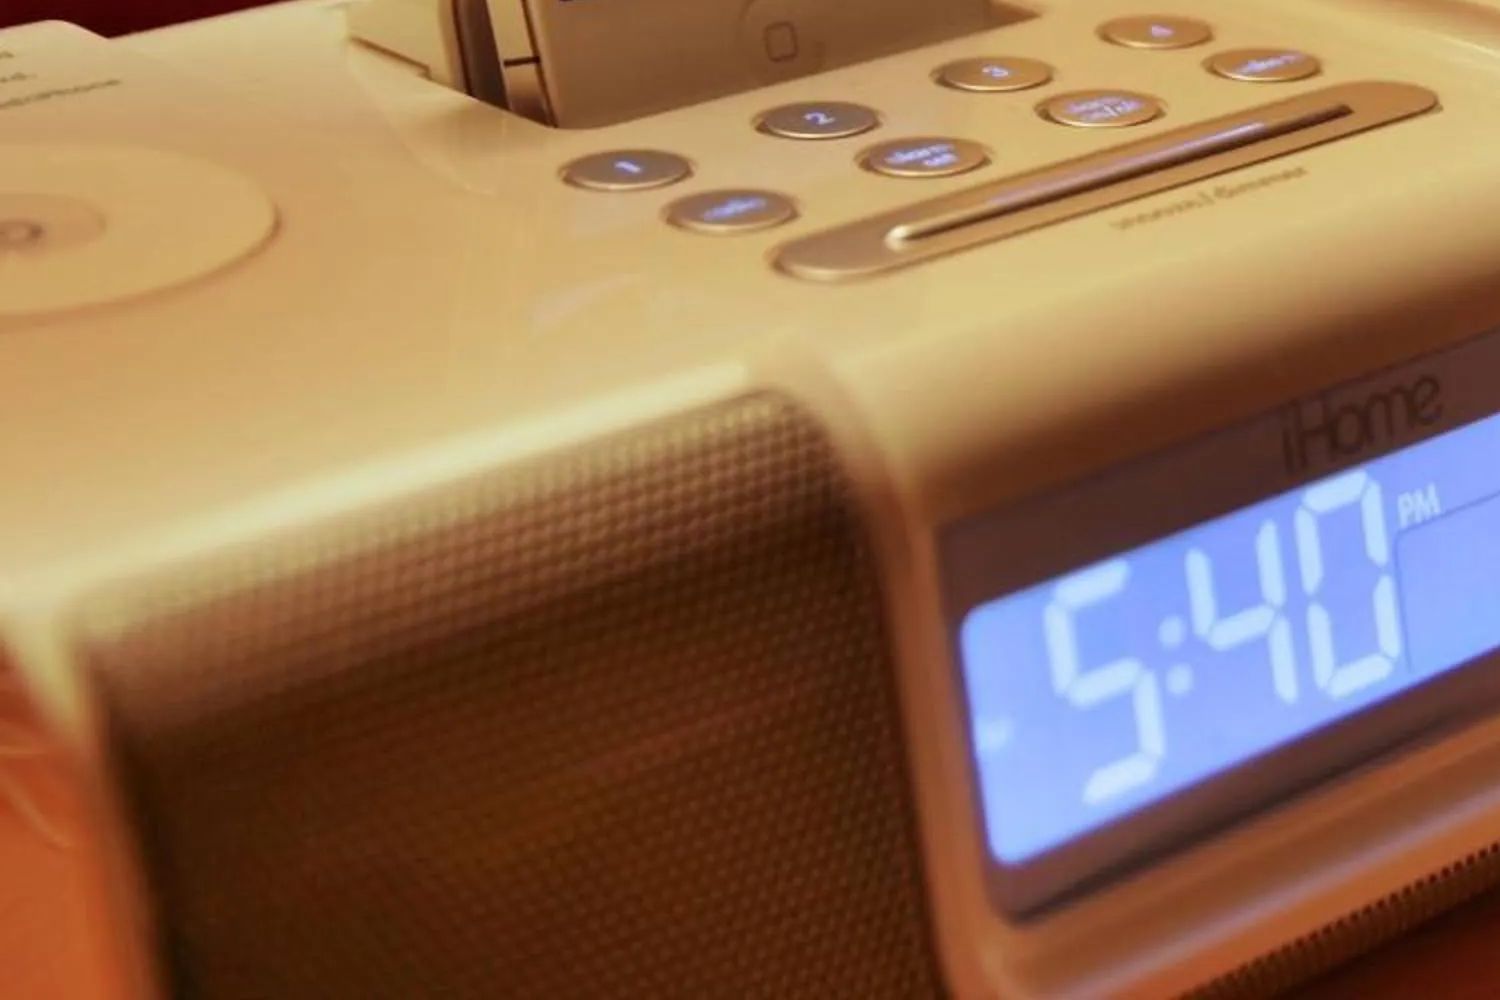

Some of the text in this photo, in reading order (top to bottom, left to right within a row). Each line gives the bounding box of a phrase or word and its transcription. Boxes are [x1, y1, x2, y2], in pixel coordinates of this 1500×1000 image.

[804, 111, 835, 125] 2
[1282, 374, 1443, 474] iHome
[1042, 469, 1441, 806] 5:40 PM
